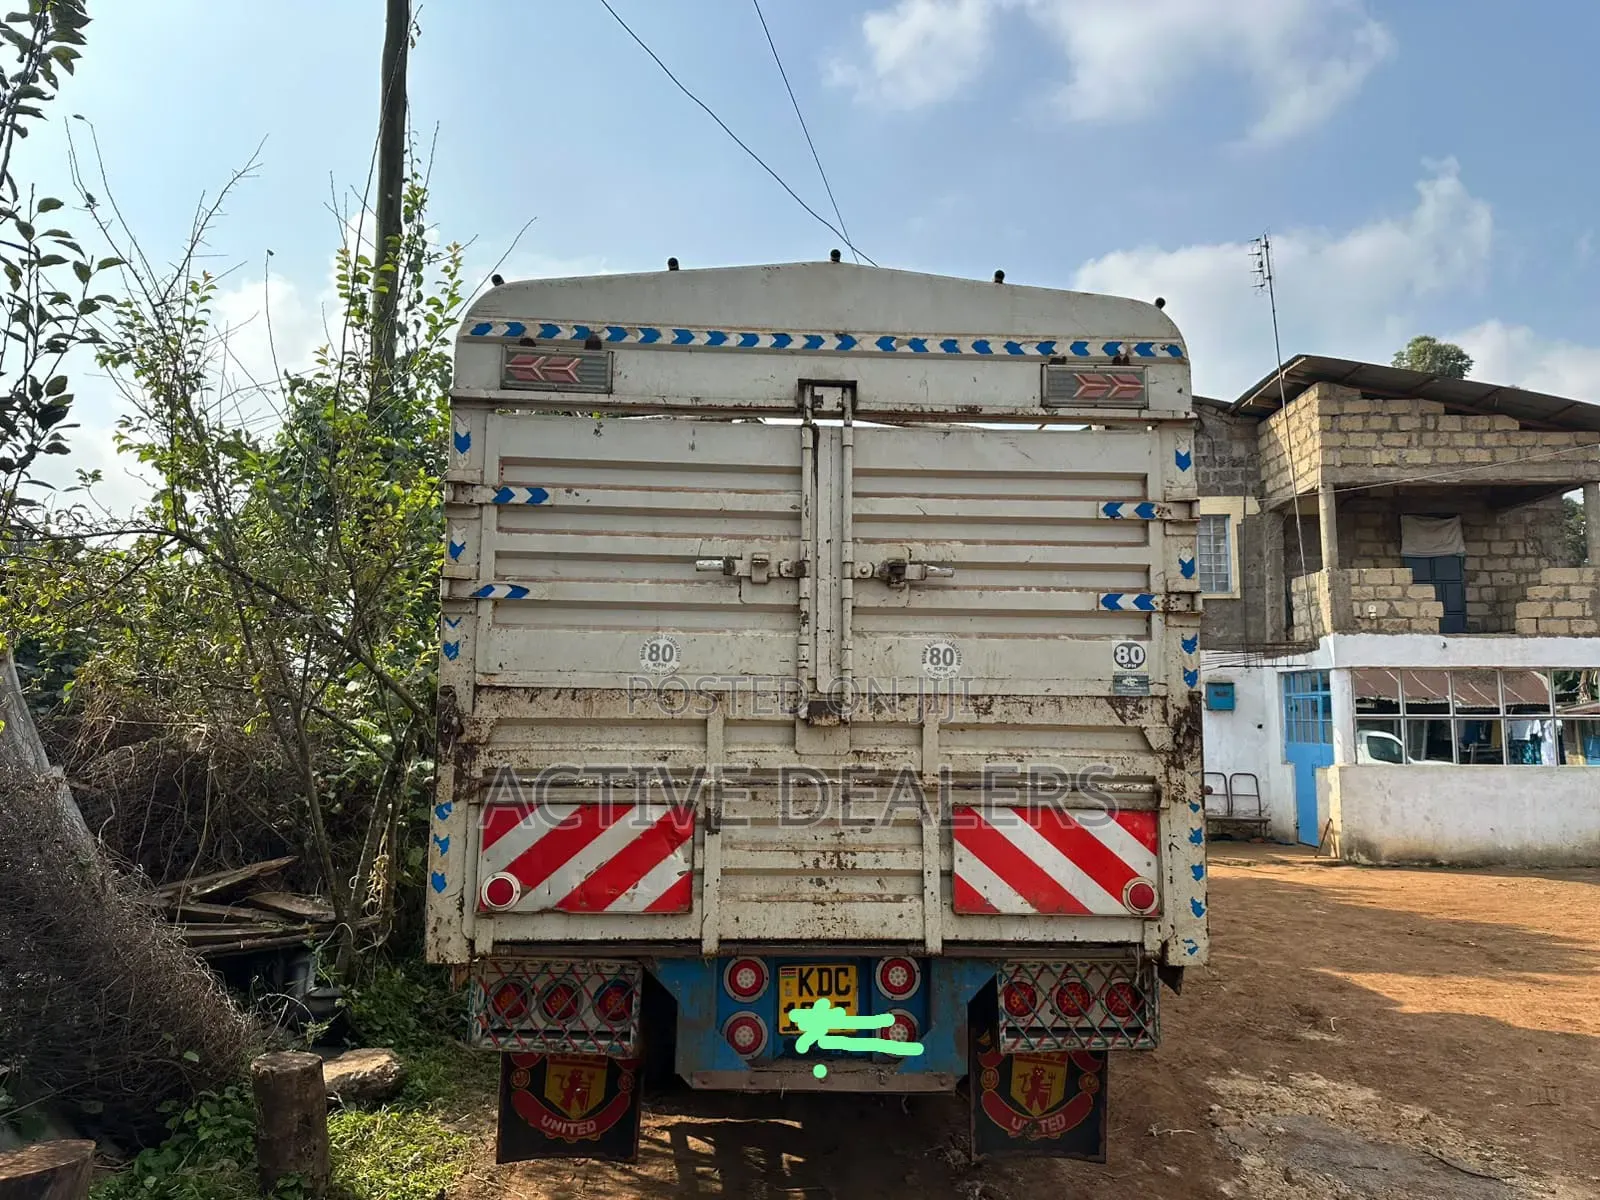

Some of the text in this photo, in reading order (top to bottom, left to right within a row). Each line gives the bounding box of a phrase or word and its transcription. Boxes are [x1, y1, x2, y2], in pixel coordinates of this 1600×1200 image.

[648, 643, 673, 662] 80
[930, 647, 954, 666] 80
[1116, 645, 1144, 663] 80
[798, 967, 851, 997] KDC
[540, 1114, 597, 1136] UNITED
[1011, 1113, 1066, 1133] UTED
